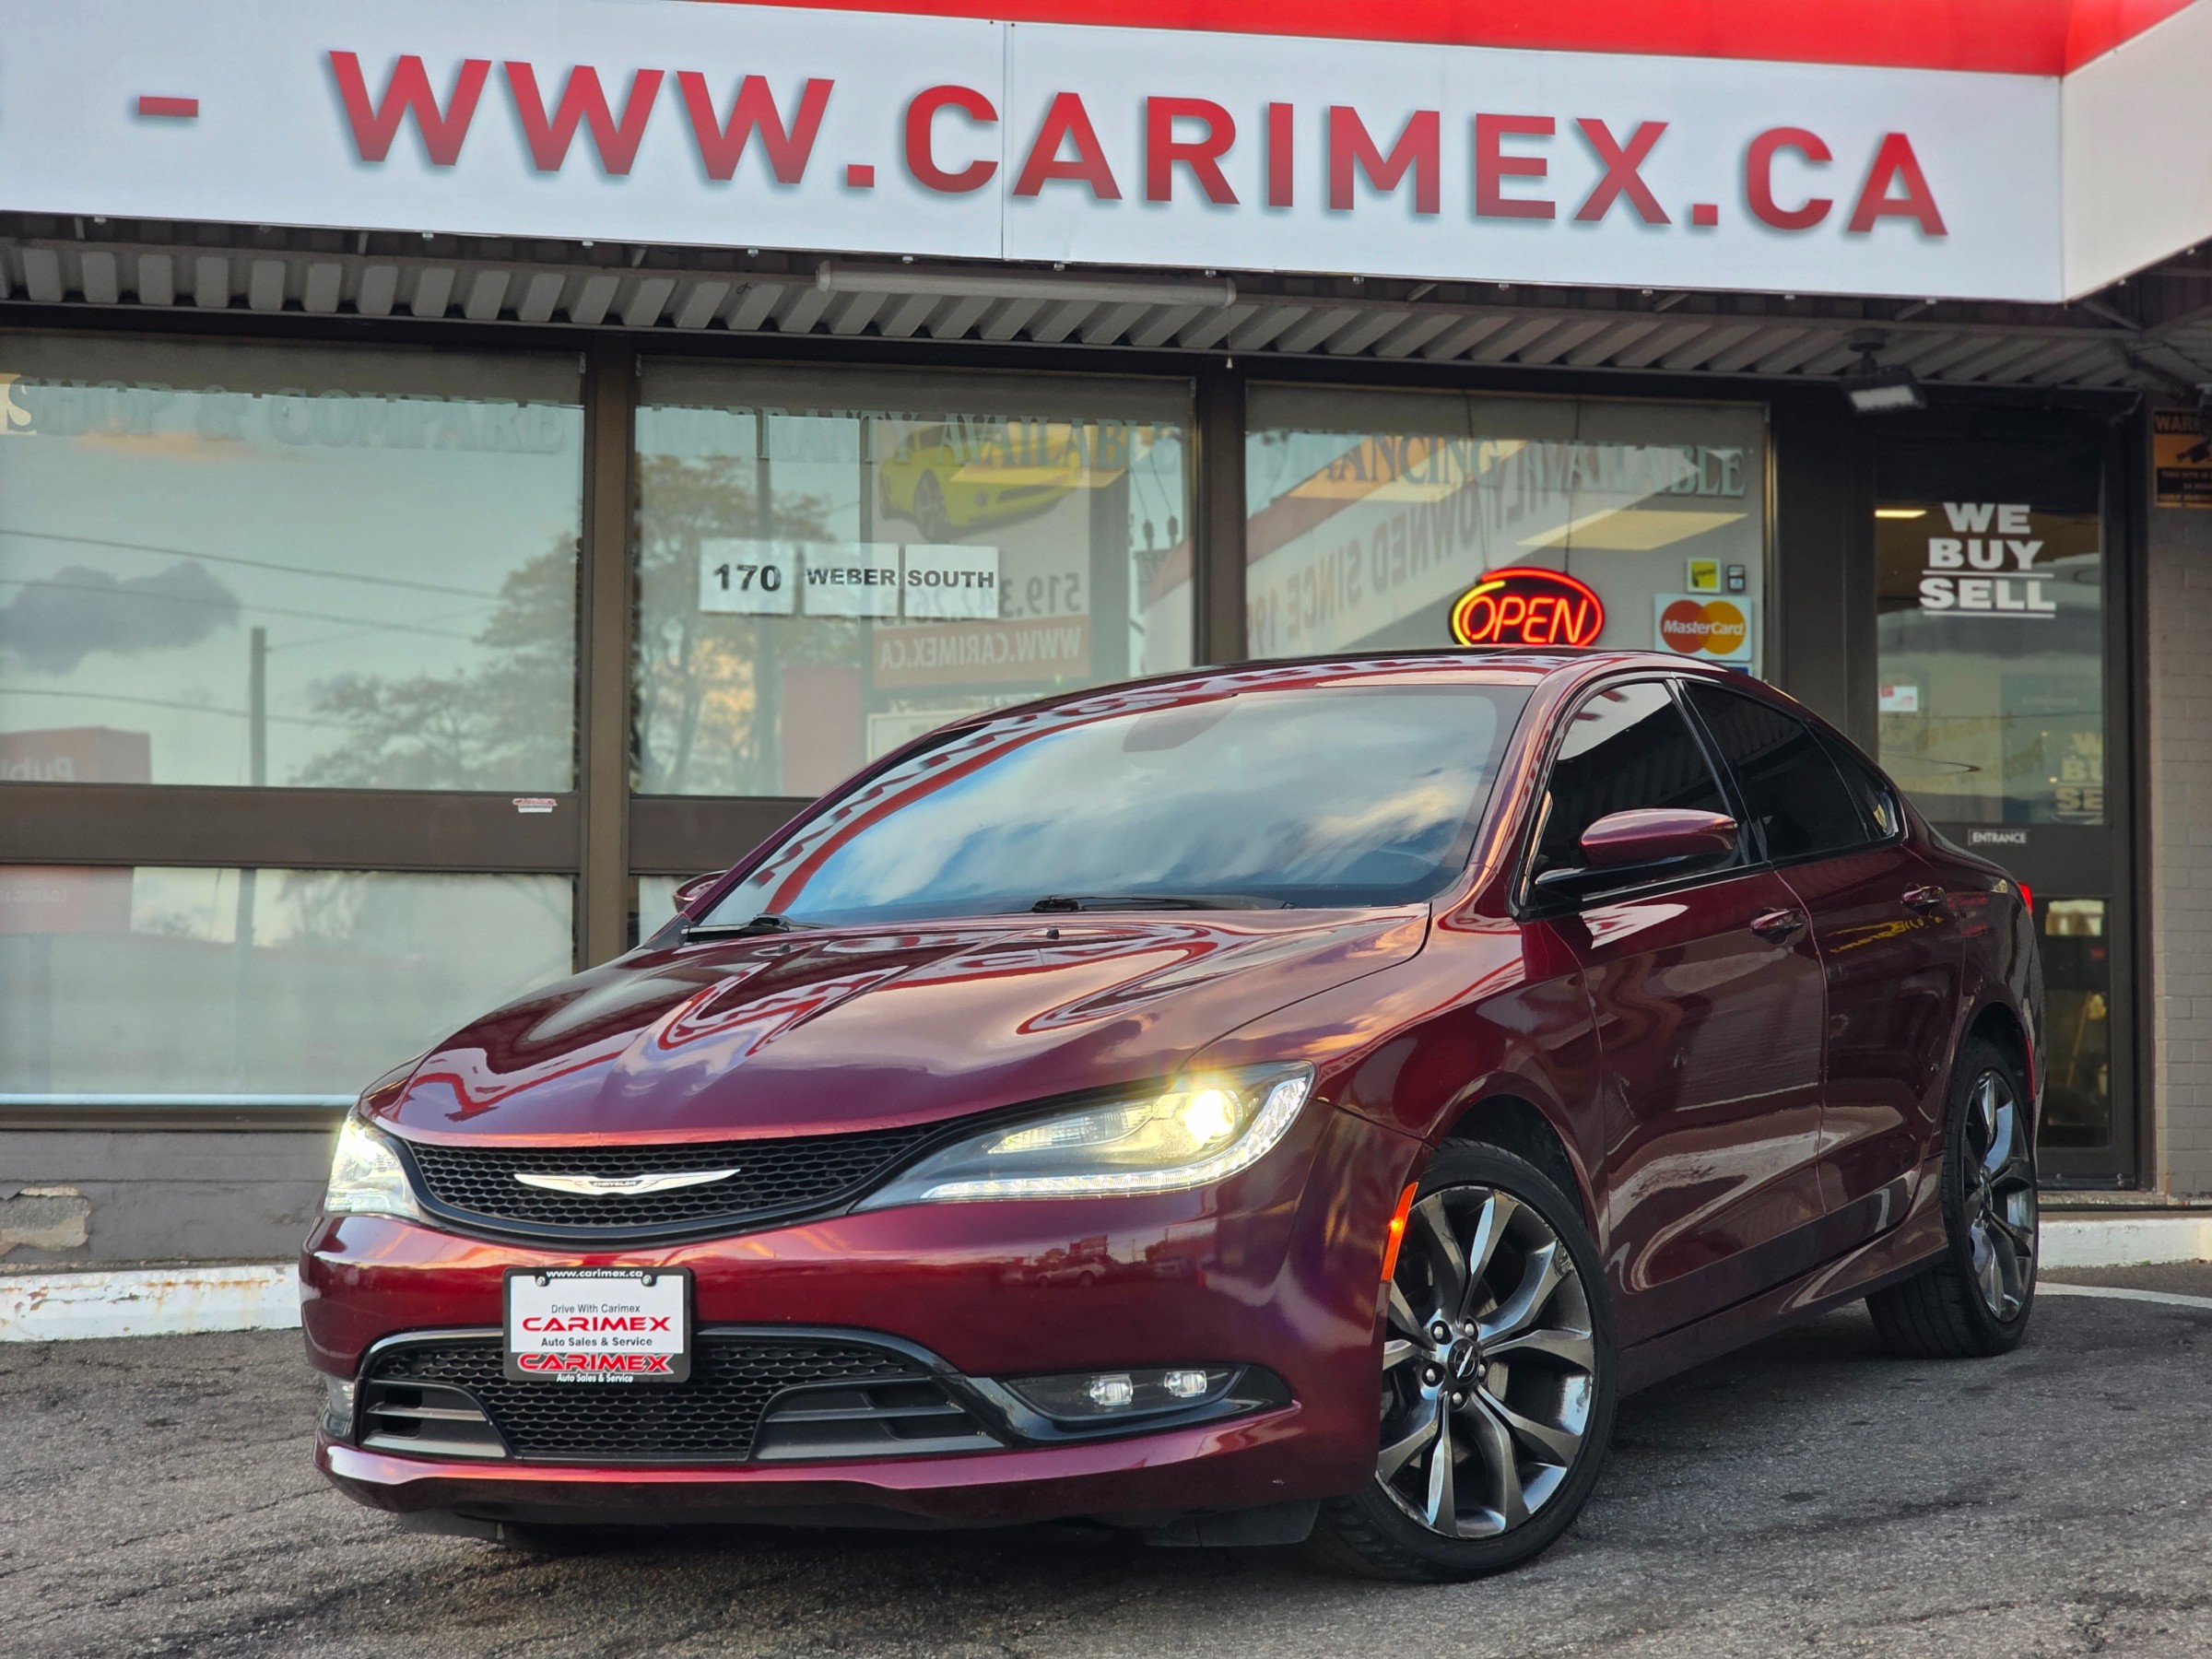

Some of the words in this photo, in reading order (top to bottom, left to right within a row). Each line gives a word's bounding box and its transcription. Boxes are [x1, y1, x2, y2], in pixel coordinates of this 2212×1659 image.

[328, 50, 1948, 237] WWW.CARIMEX.CA
[1942, 501, 2032, 535] WE
[1928, 537, 2045, 571] BUY
[712, 563, 782, 592] 170
[805, 568, 897, 587] WEBER
[906, 569, 995, 589] SOUTH
[1919, 577, 2057, 611] SELL
[1461, 594, 1590, 646] OPEN
[1663, 619, 1745, 636] MasterCard
[1971, 831, 2028, 844] ENTRANCE
[546, 1269, 644, 1278] www.carimex.ca
[551, 1304, 575, 1313] Drive
[577, 1304, 599, 1313] With
[601, 1303, 641, 1313] Carimex
[522, 1316, 671, 1332] CARIMEX
[541, 1337, 565, 1347] Auto
[568, 1337, 597, 1347] Sales
[601, 1337, 609, 1347] &
[612, 1336, 653, 1347] Service
[518, 1353, 673, 1373] CARIMEX
[556, 1372, 575, 1382] Auto
[576, 1372, 597, 1382] Sales
[597, 1372, 605, 1382] &
[606, 1372, 634, 1382] Service
